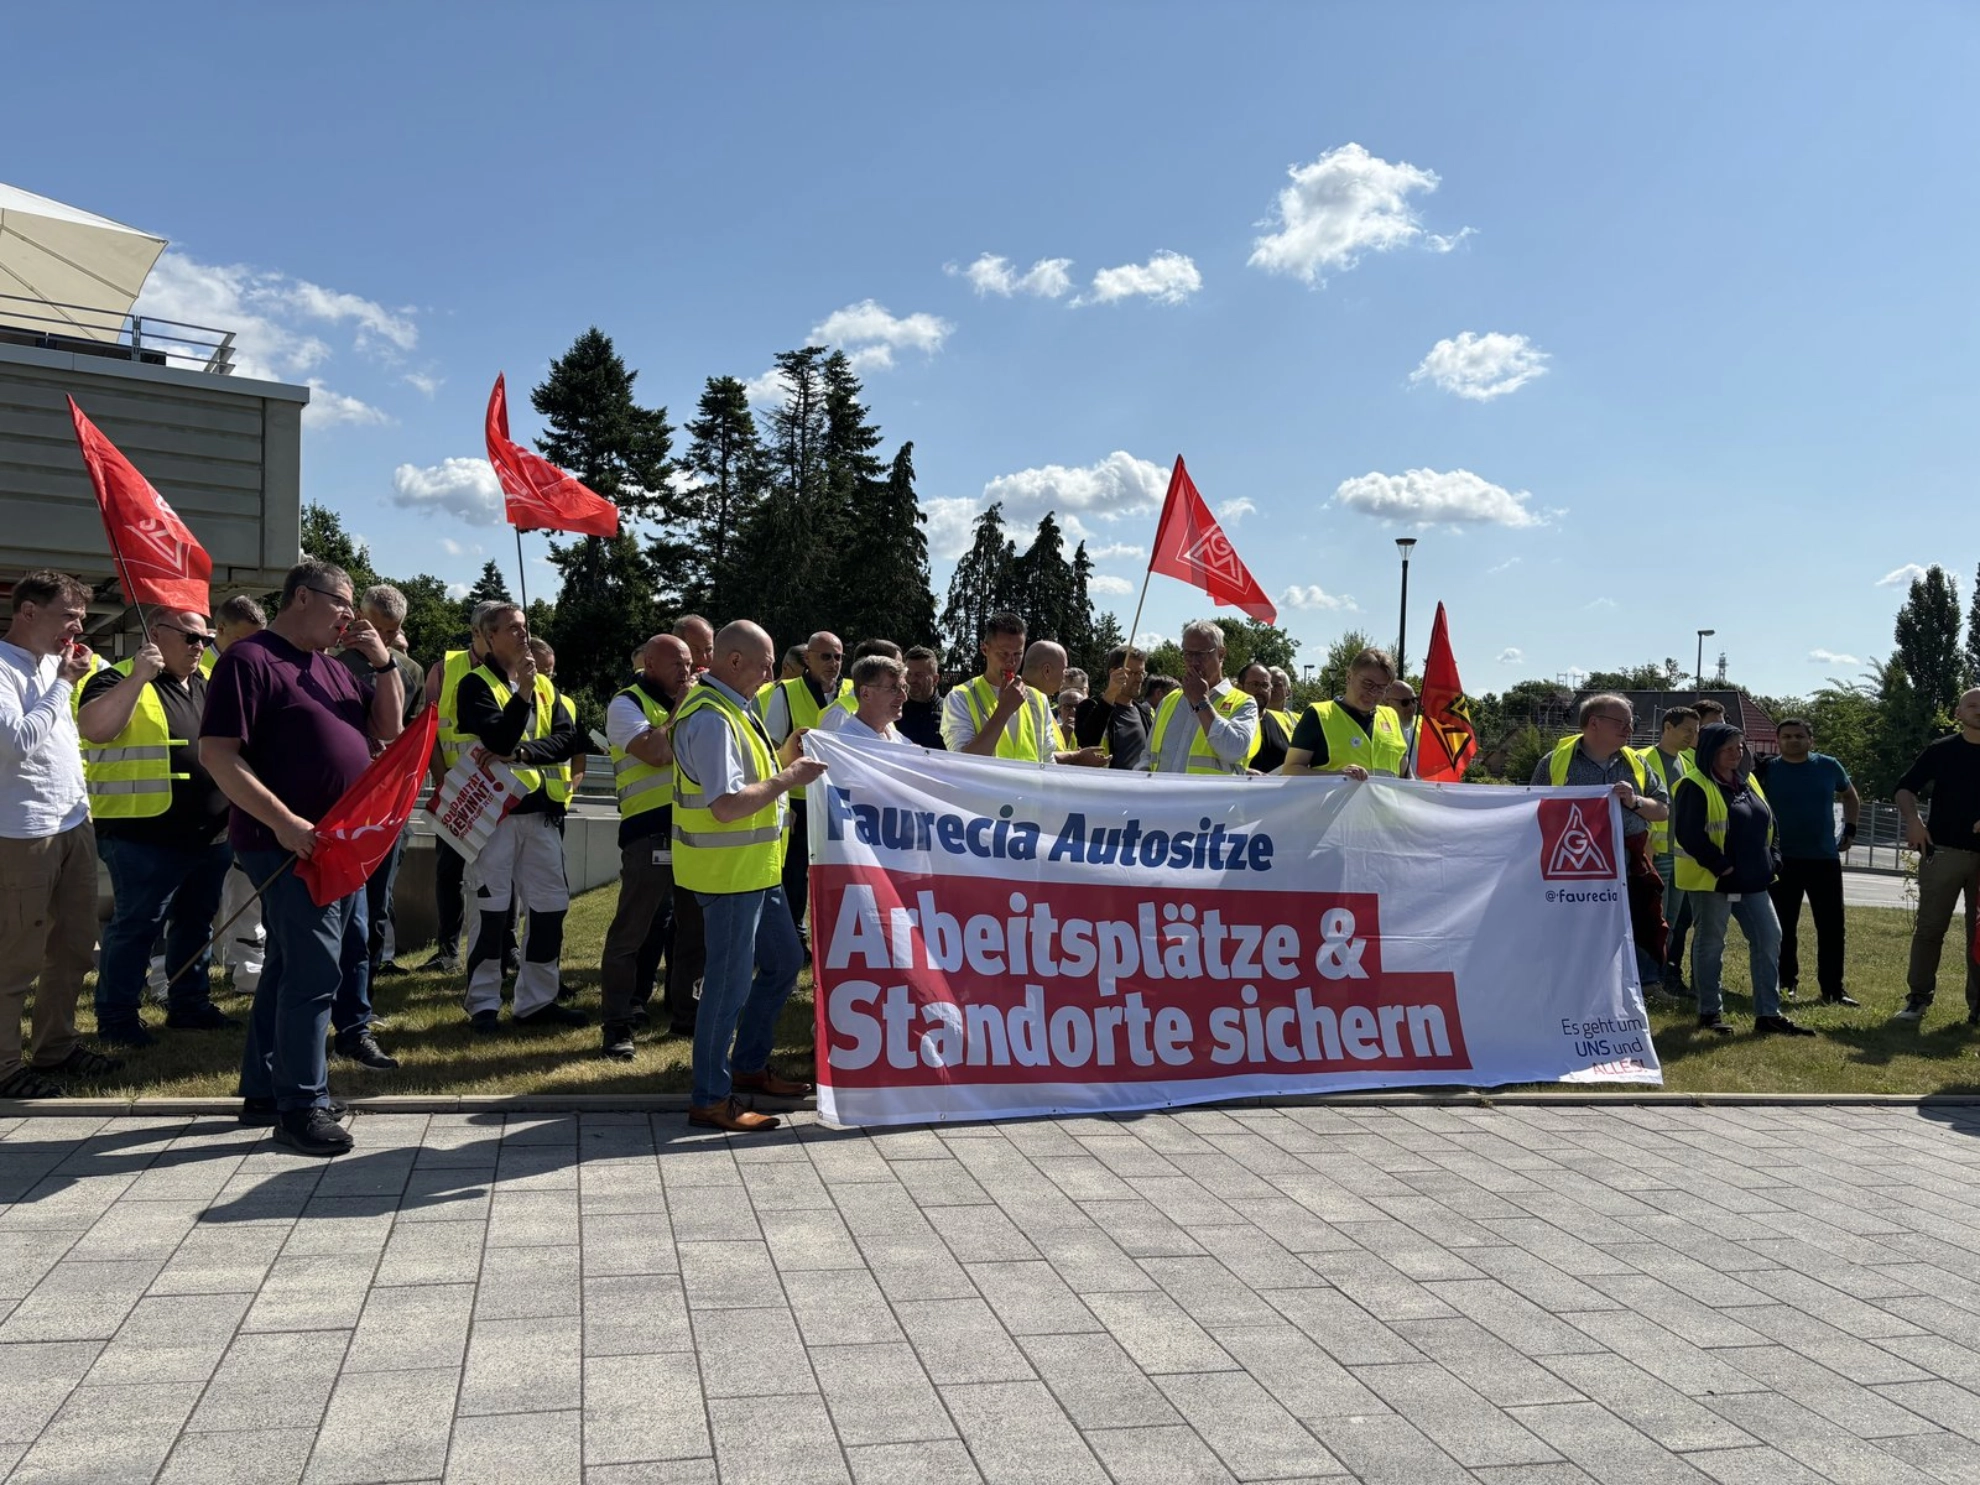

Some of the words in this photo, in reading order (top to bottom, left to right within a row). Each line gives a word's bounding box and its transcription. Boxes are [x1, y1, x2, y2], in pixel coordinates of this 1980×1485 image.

[441, 772, 481, 828] SOLIDARITÄT
[826, 785, 1041, 861] Faurecia
[1048, 812, 1274, 872] Autositze
[826, 883, 1300, 997] Arbeitsplätze
[1315, 907, 1369, 979] &
[827, 980, 1194, 1070] Standorte
[1209, 984, 1454, 1064] sichern
[1561, 1018, 1580, 1036] Es
[1582, 1017, 1616, 1039] geht
[1617, 1018, 1643, 1032] um
[1574, 1040, 1611, 1057] UNS
[1613, 1037, 1644, 1055] und
[1592, 1059, 1648, 1075] ALLES!
